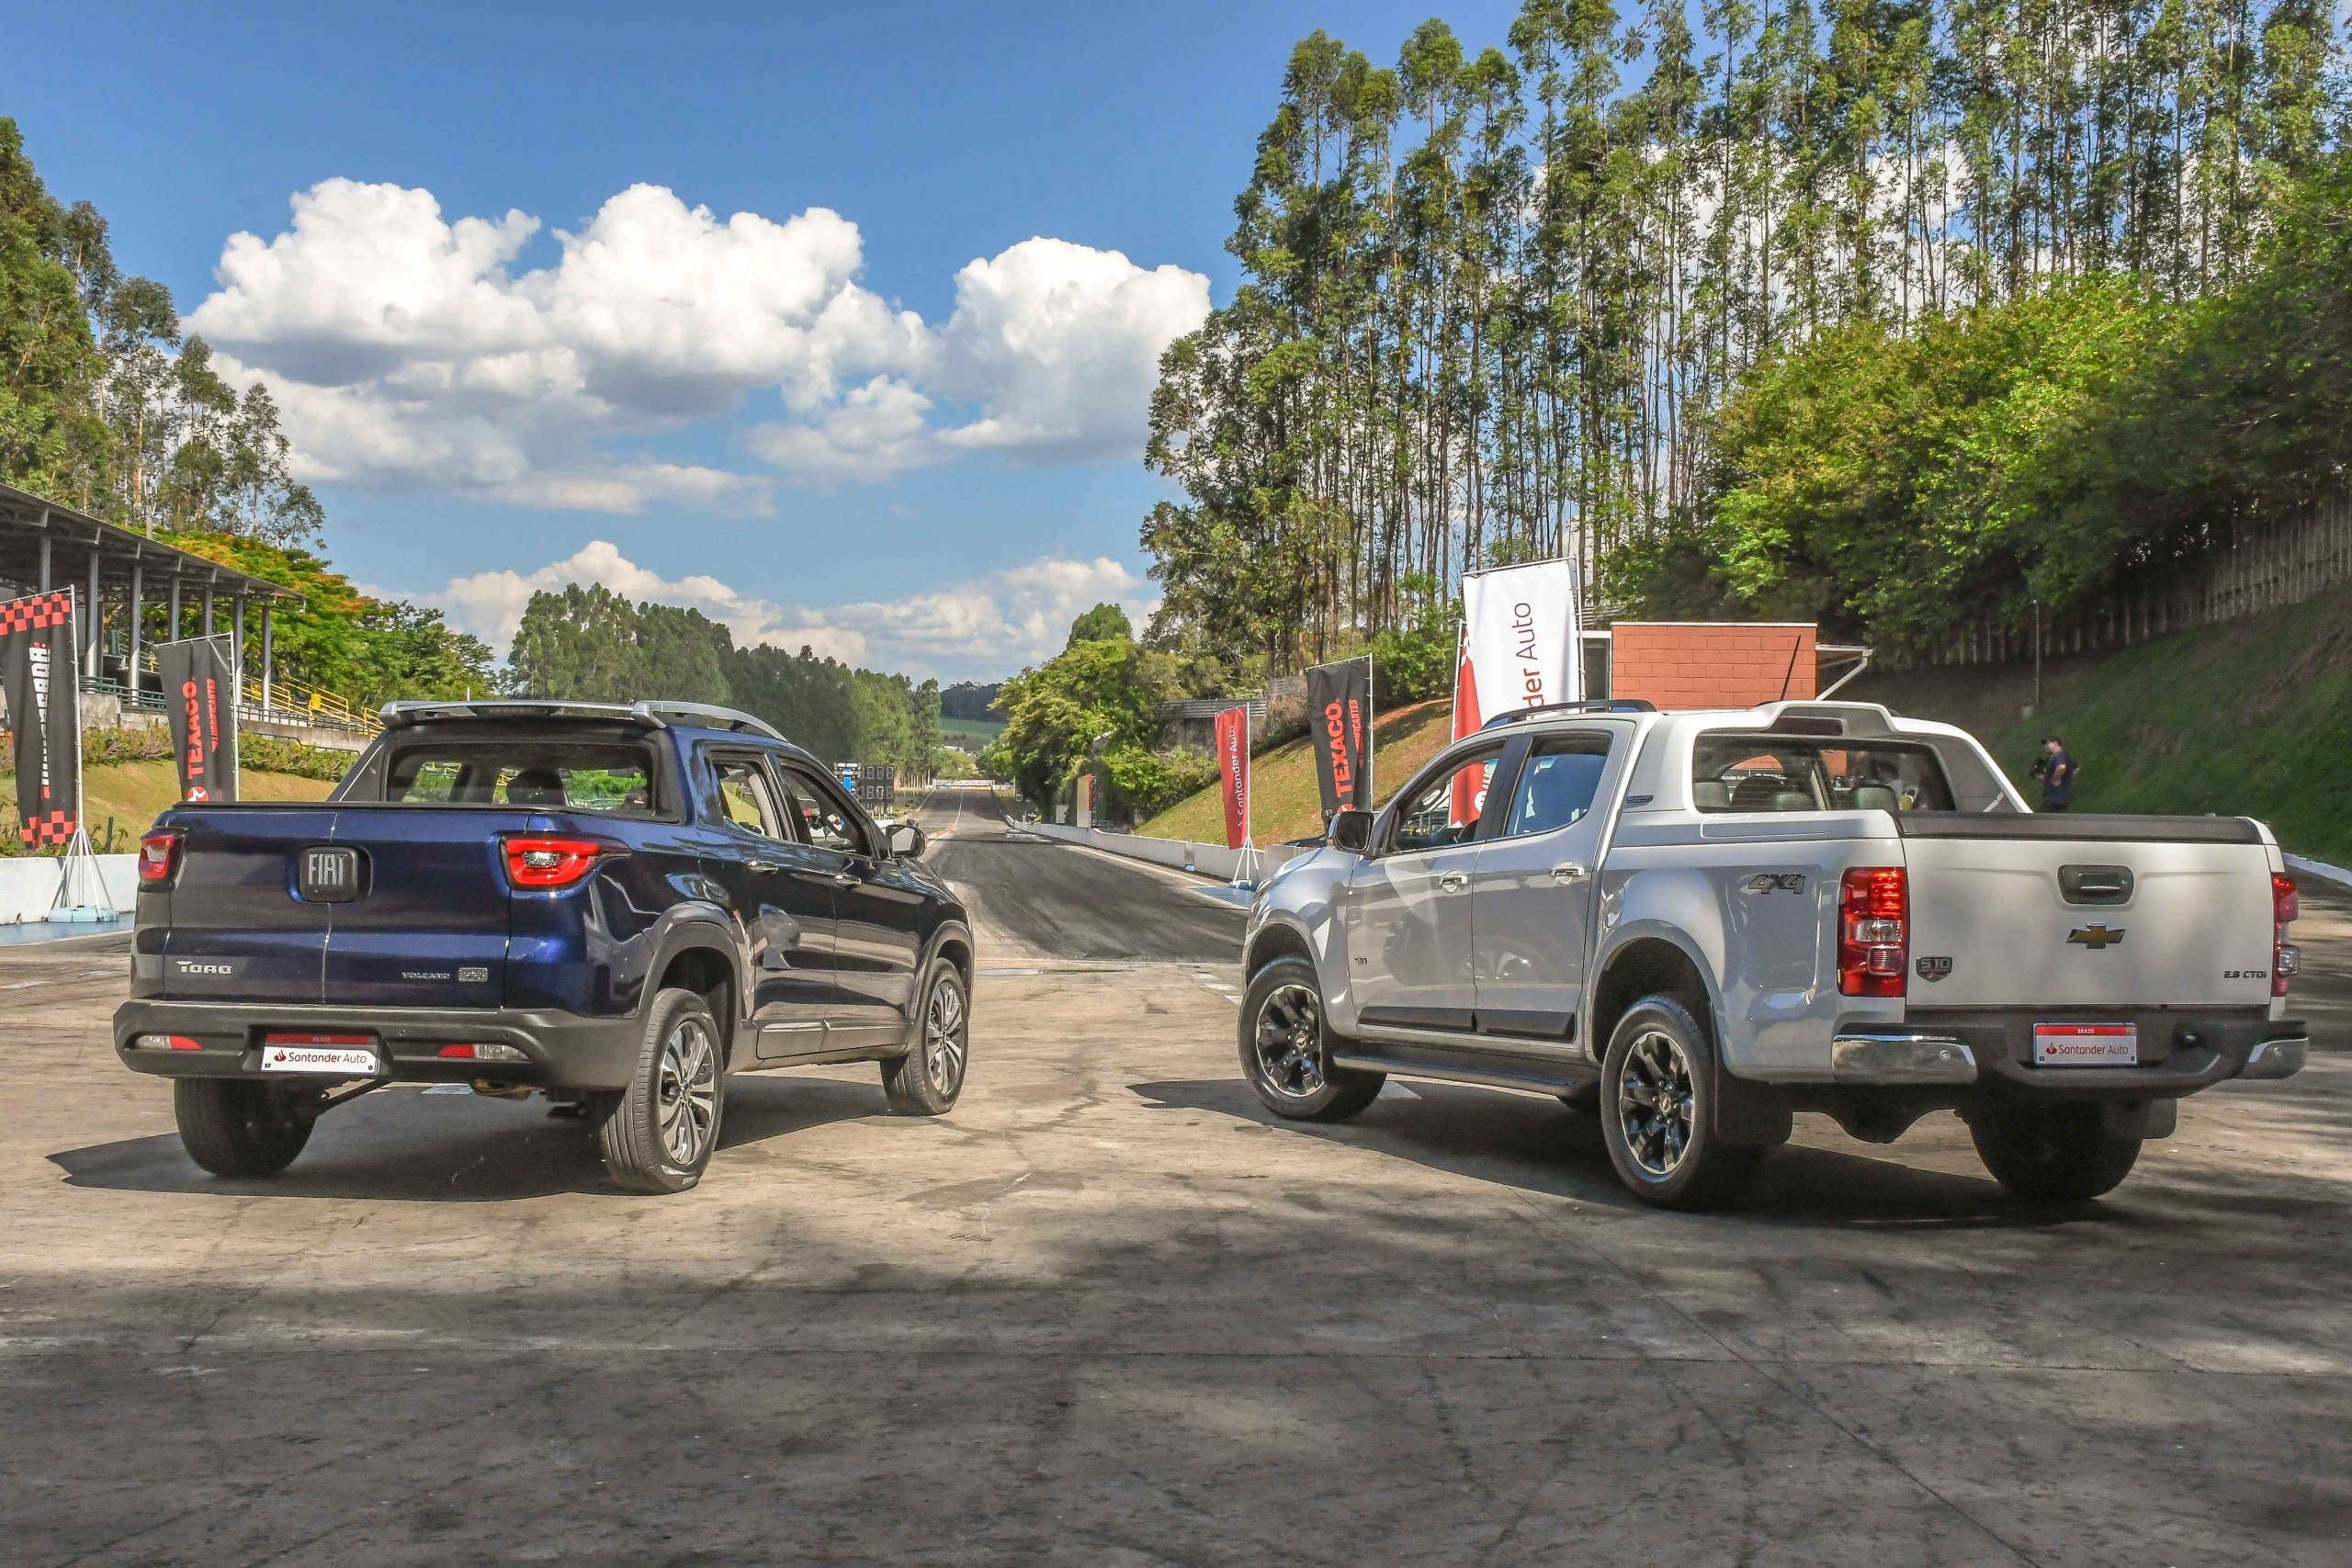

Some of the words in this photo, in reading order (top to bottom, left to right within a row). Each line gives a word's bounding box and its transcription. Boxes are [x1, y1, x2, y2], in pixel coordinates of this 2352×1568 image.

[1511, 603, 1538, 660] Auto
[206, 678, 219, 742] LUBRIFICANTES
[182, 681, 205, 780] TEXACO
[1227, 724, 1238, 752] Auto
[1324, 702, 1353, 798] TEXACO
[308, 853, 348, 886] FIAT
[176, 960, 232, 975] TORO
[1920, 958, 1951, 969] S10
[288, 1052, 341, 1064] Santander
[343, 1054, 367, 1064] Auto
[2058, 1044, 2106, 1055] Santander
[2108, 1044, 2129, 1055] Auto
